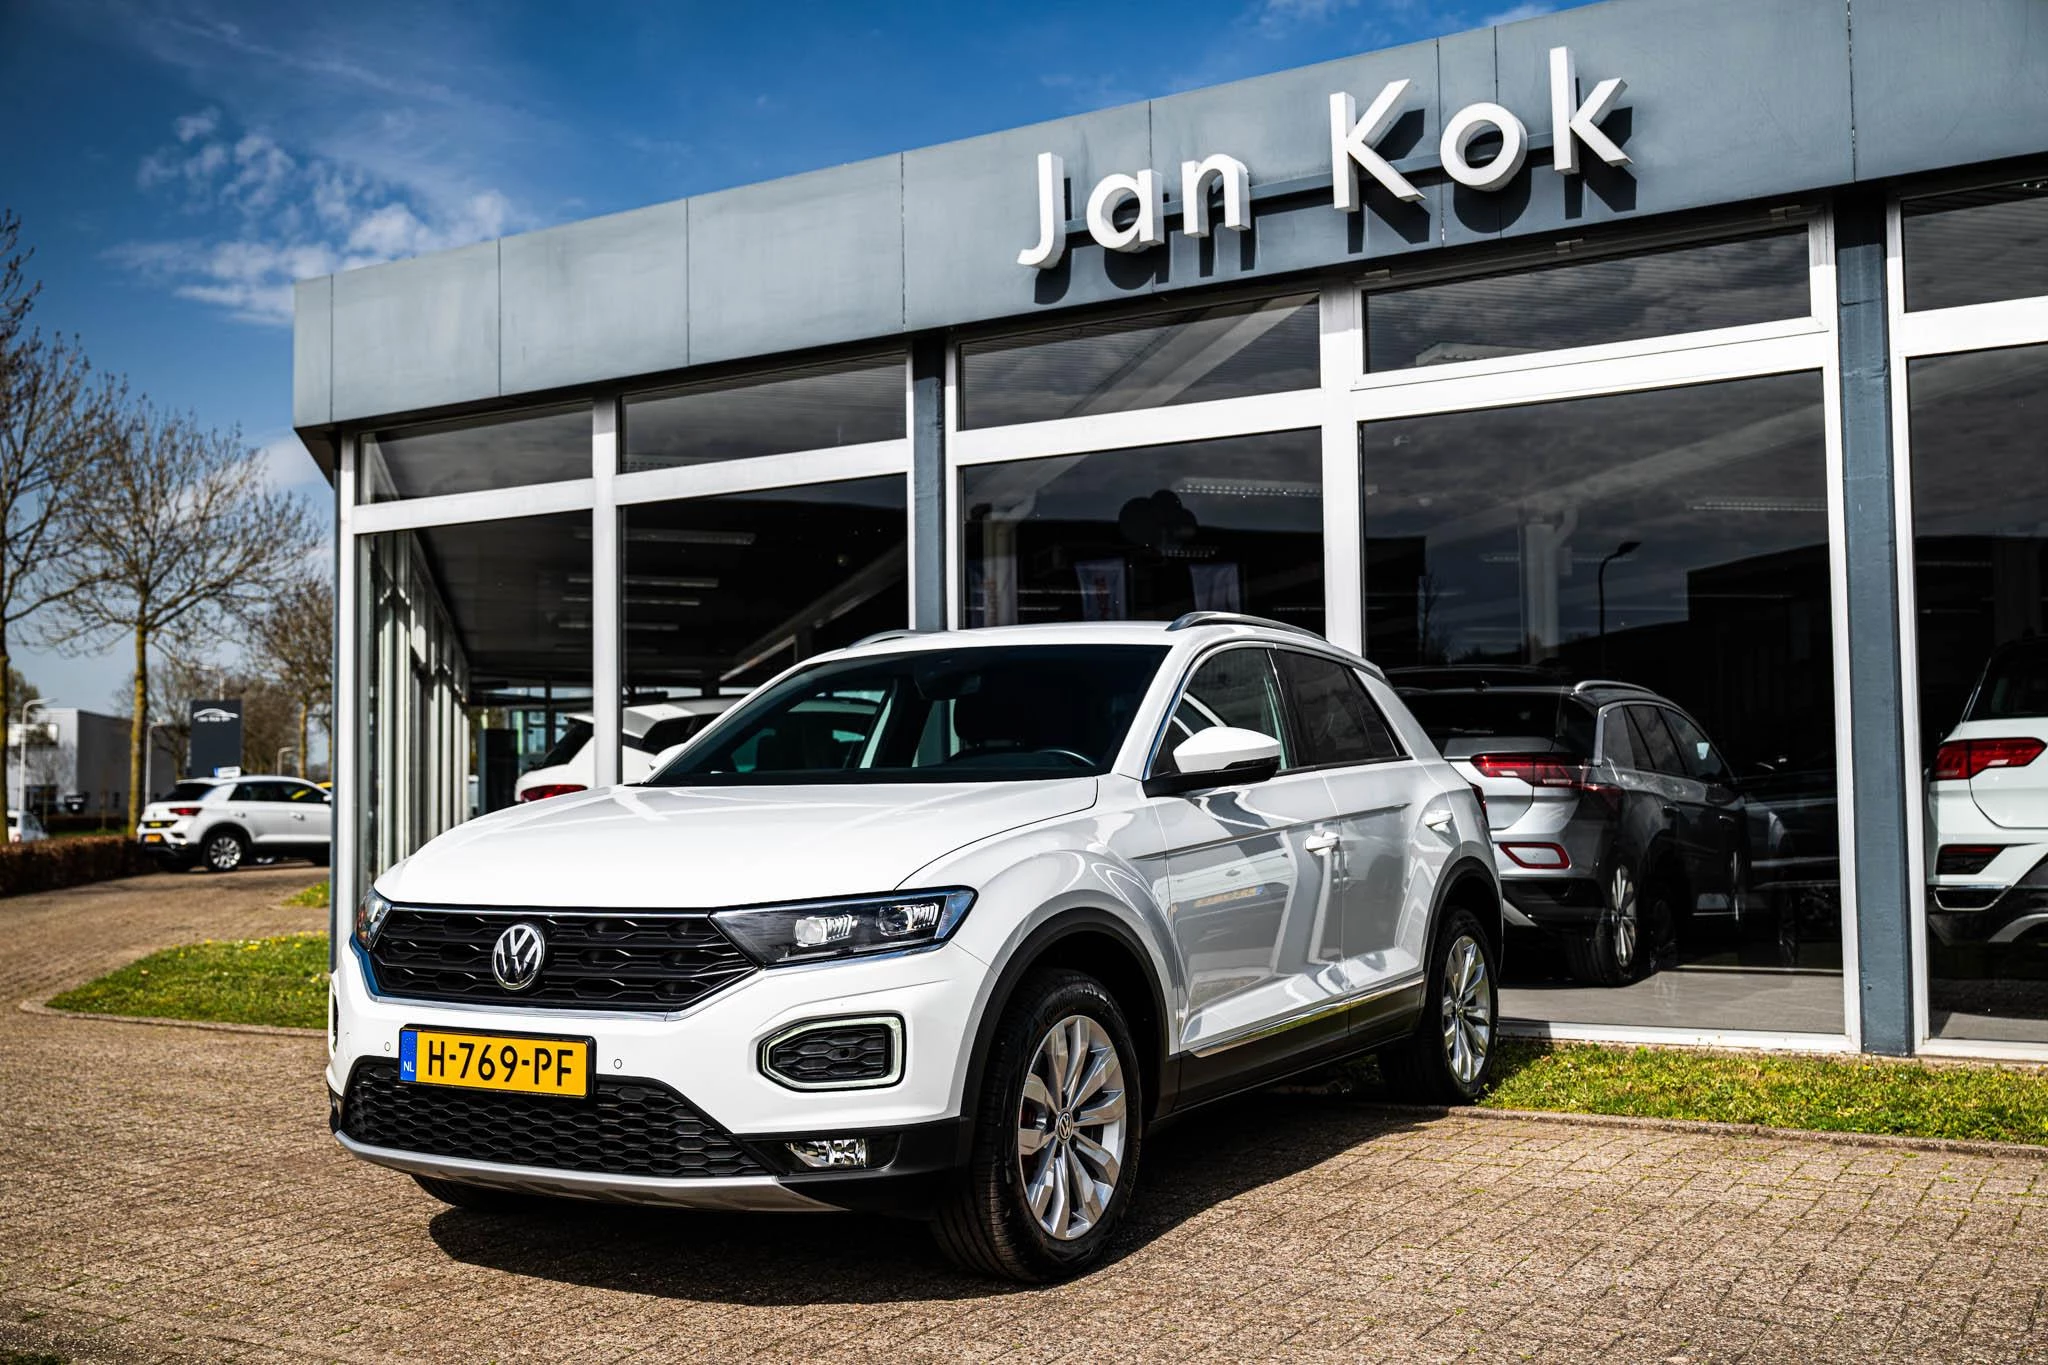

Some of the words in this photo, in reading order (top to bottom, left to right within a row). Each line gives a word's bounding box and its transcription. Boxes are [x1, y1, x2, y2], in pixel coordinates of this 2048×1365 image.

[1017, 152, 1250, 269] Jan
[1330, 46, 1633, 212] Kok
[493, 923, 542, 987] VW
[403, 1060, 415, 1073] NL
[428, 1040, 573, 1087] H-769-PF
